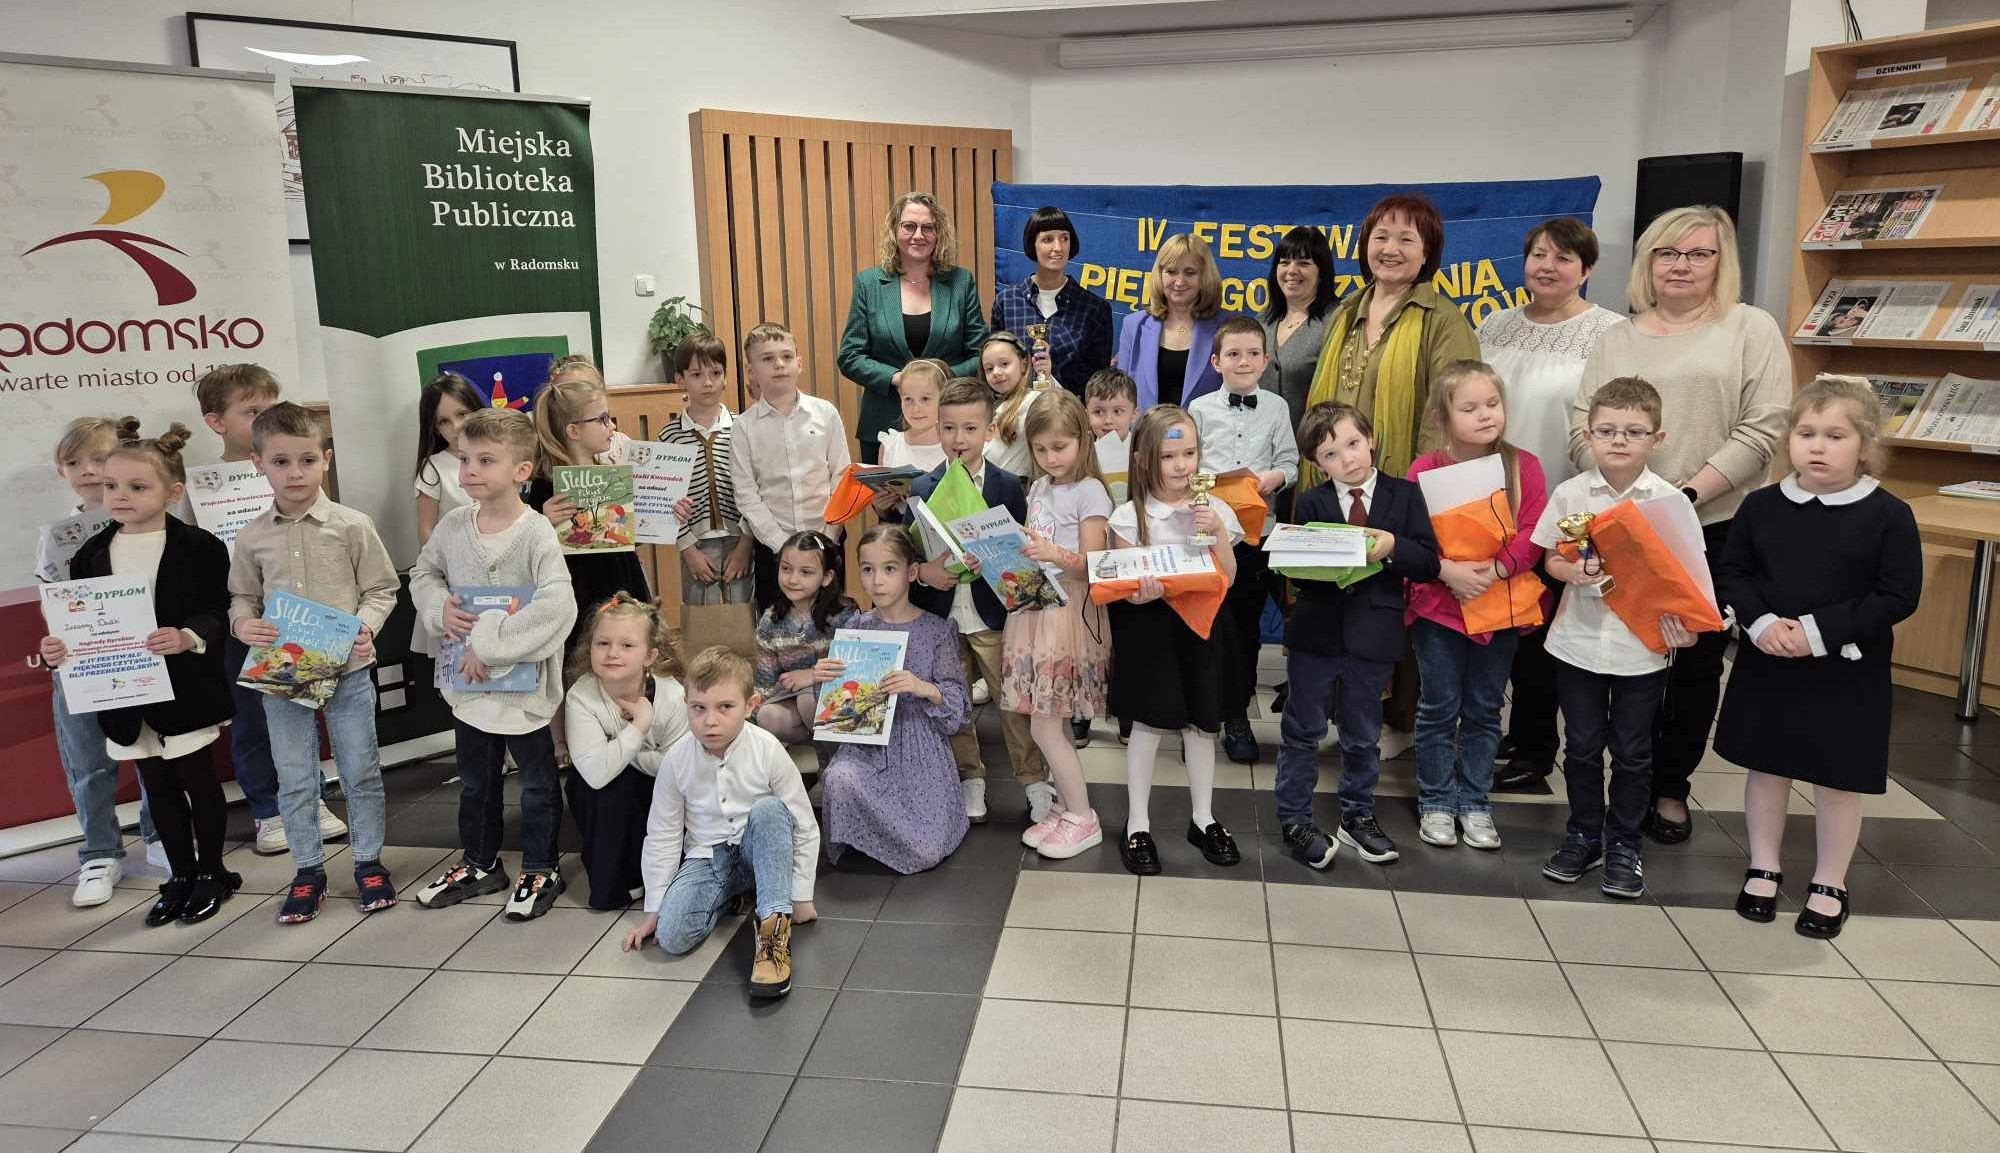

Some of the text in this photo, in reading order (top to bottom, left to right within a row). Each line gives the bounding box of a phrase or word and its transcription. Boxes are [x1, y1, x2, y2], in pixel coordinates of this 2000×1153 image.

[1875, 63, 1921, 75] DZIENNIKI
[455, 127, 572, 163] Miejska
[421, 163, 574, 193] Biblioteka
[429, 201, 576, 228] Publiczna
[1137, 217, 1168, 252] IV
[494, 258, 580, 271] w Radomsku
[0, 314, 265, 373] adomsko
[0, 372, 69, 392] warte
[78, 367, 159, 388] miasto
[166, 363, 196, 384] od
[655, 454, 692, 463] DYPLOM
[228, 472, 266, 482] DYPLO
[980, 516, 1011, 532] DYPLOM
[94, 586, 146, 600] DYPLOM
[97, 651, 143, 662] FESTIWALU
[112, 656, 152, 667] CZYTANIA
